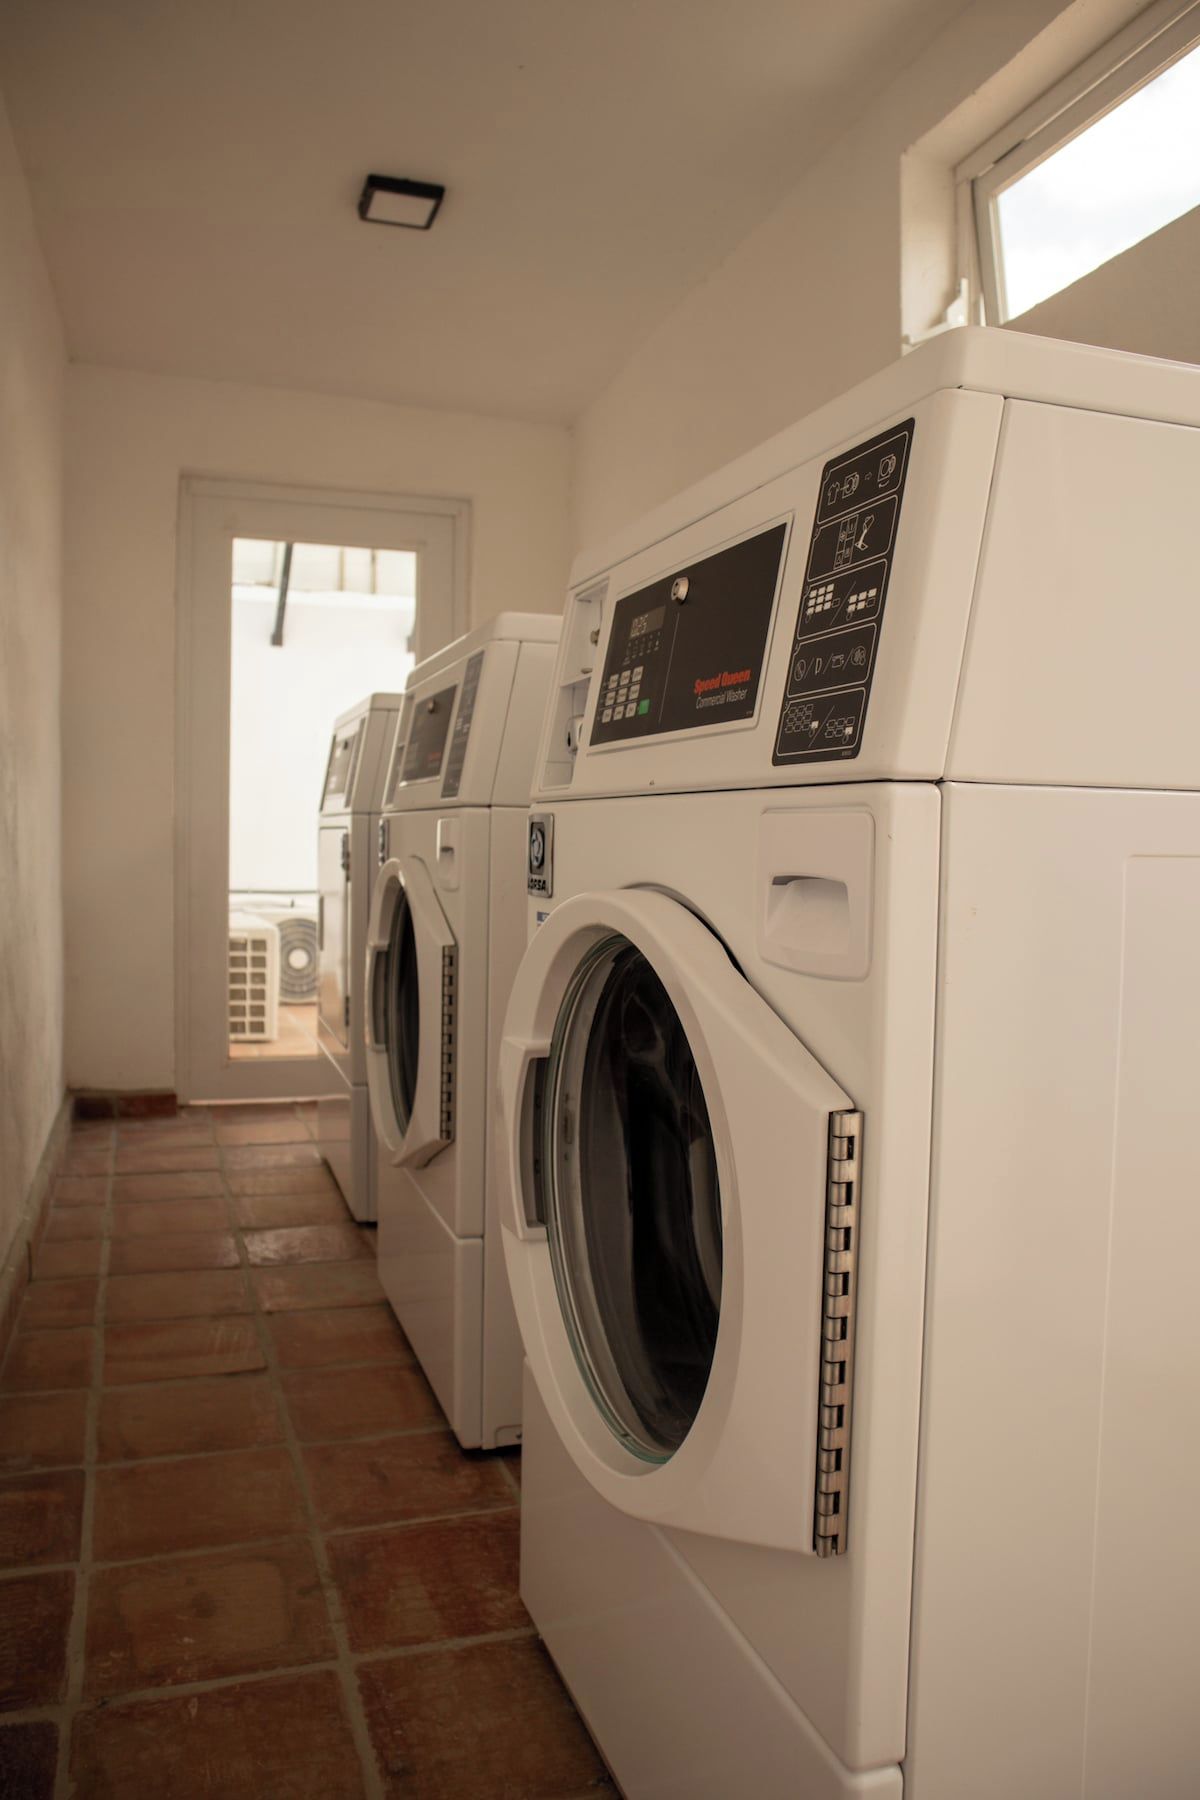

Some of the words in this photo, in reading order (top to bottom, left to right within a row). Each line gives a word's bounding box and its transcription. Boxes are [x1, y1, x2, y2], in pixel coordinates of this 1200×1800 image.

[694, 674, 721, 695] Speed
[721, 670, 750, 686] Queen
[696, 691, 726, 709] Commercial
[726, 688, 748, 702] Washer
